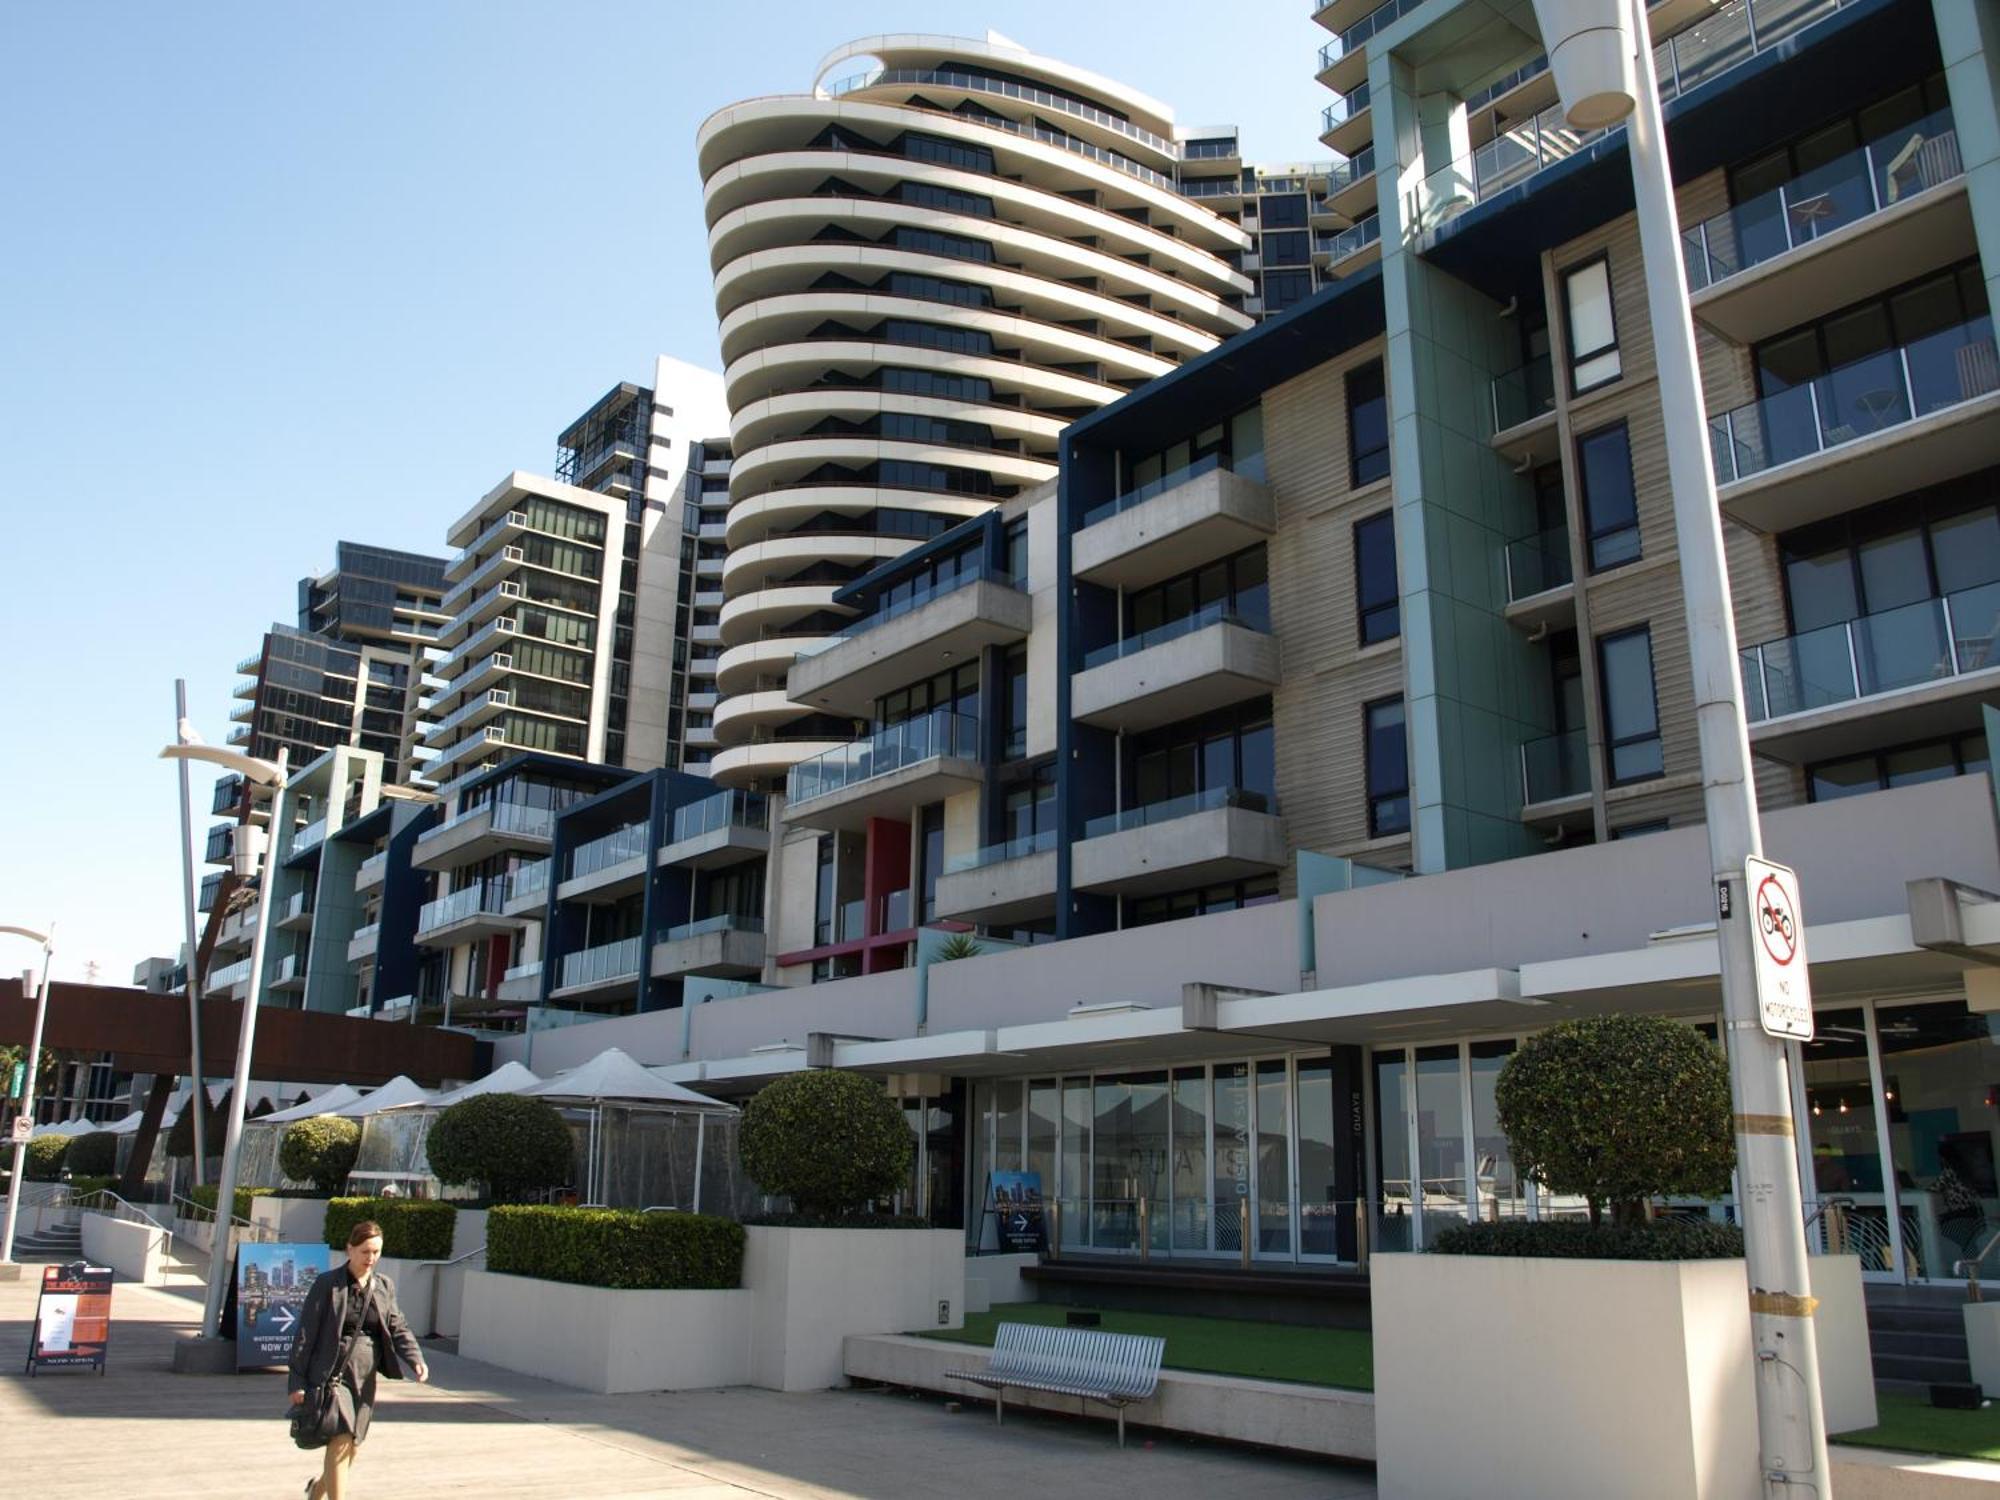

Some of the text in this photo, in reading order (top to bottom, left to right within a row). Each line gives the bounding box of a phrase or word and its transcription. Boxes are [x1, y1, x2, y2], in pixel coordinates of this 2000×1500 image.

[1779, 980, 1790, 995] NO
[1234, 1121, 1248, 1195] DISPLAY
[261, 1344, 281, 1352] NOW
